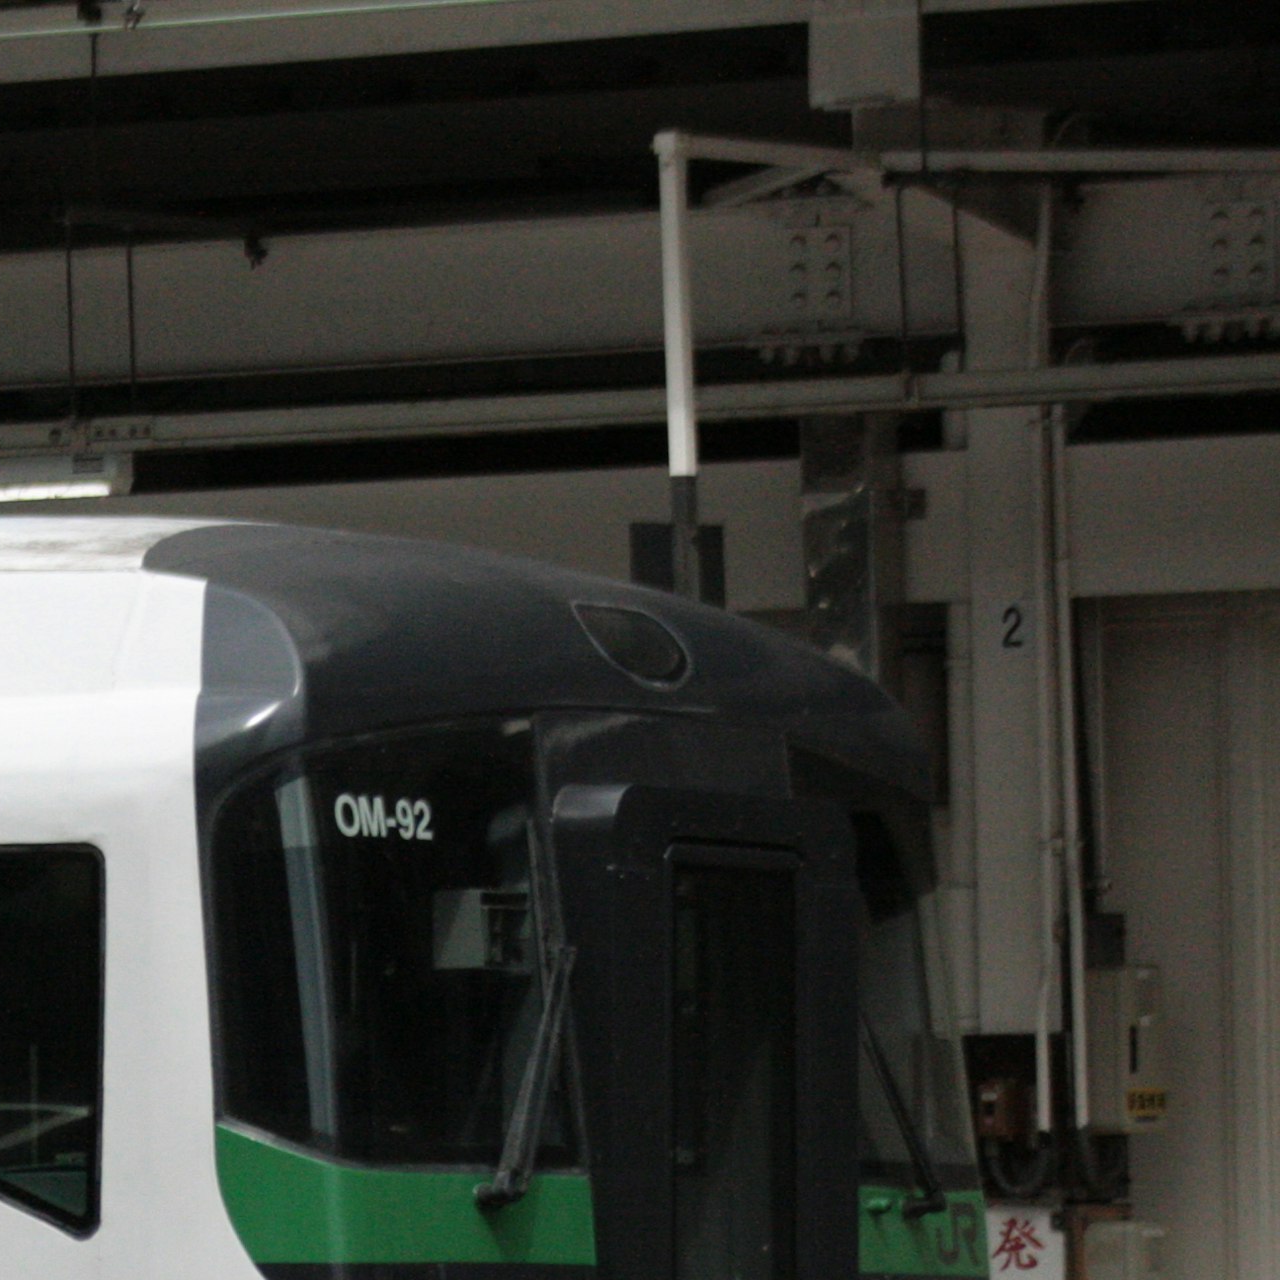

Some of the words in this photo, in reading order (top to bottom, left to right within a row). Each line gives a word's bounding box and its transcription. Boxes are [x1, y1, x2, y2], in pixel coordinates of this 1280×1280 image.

[1002, 606, 1023, 648] 2
[334, 793, 433, 841] OM-92
[937, 1202, 982, 1267] JR
